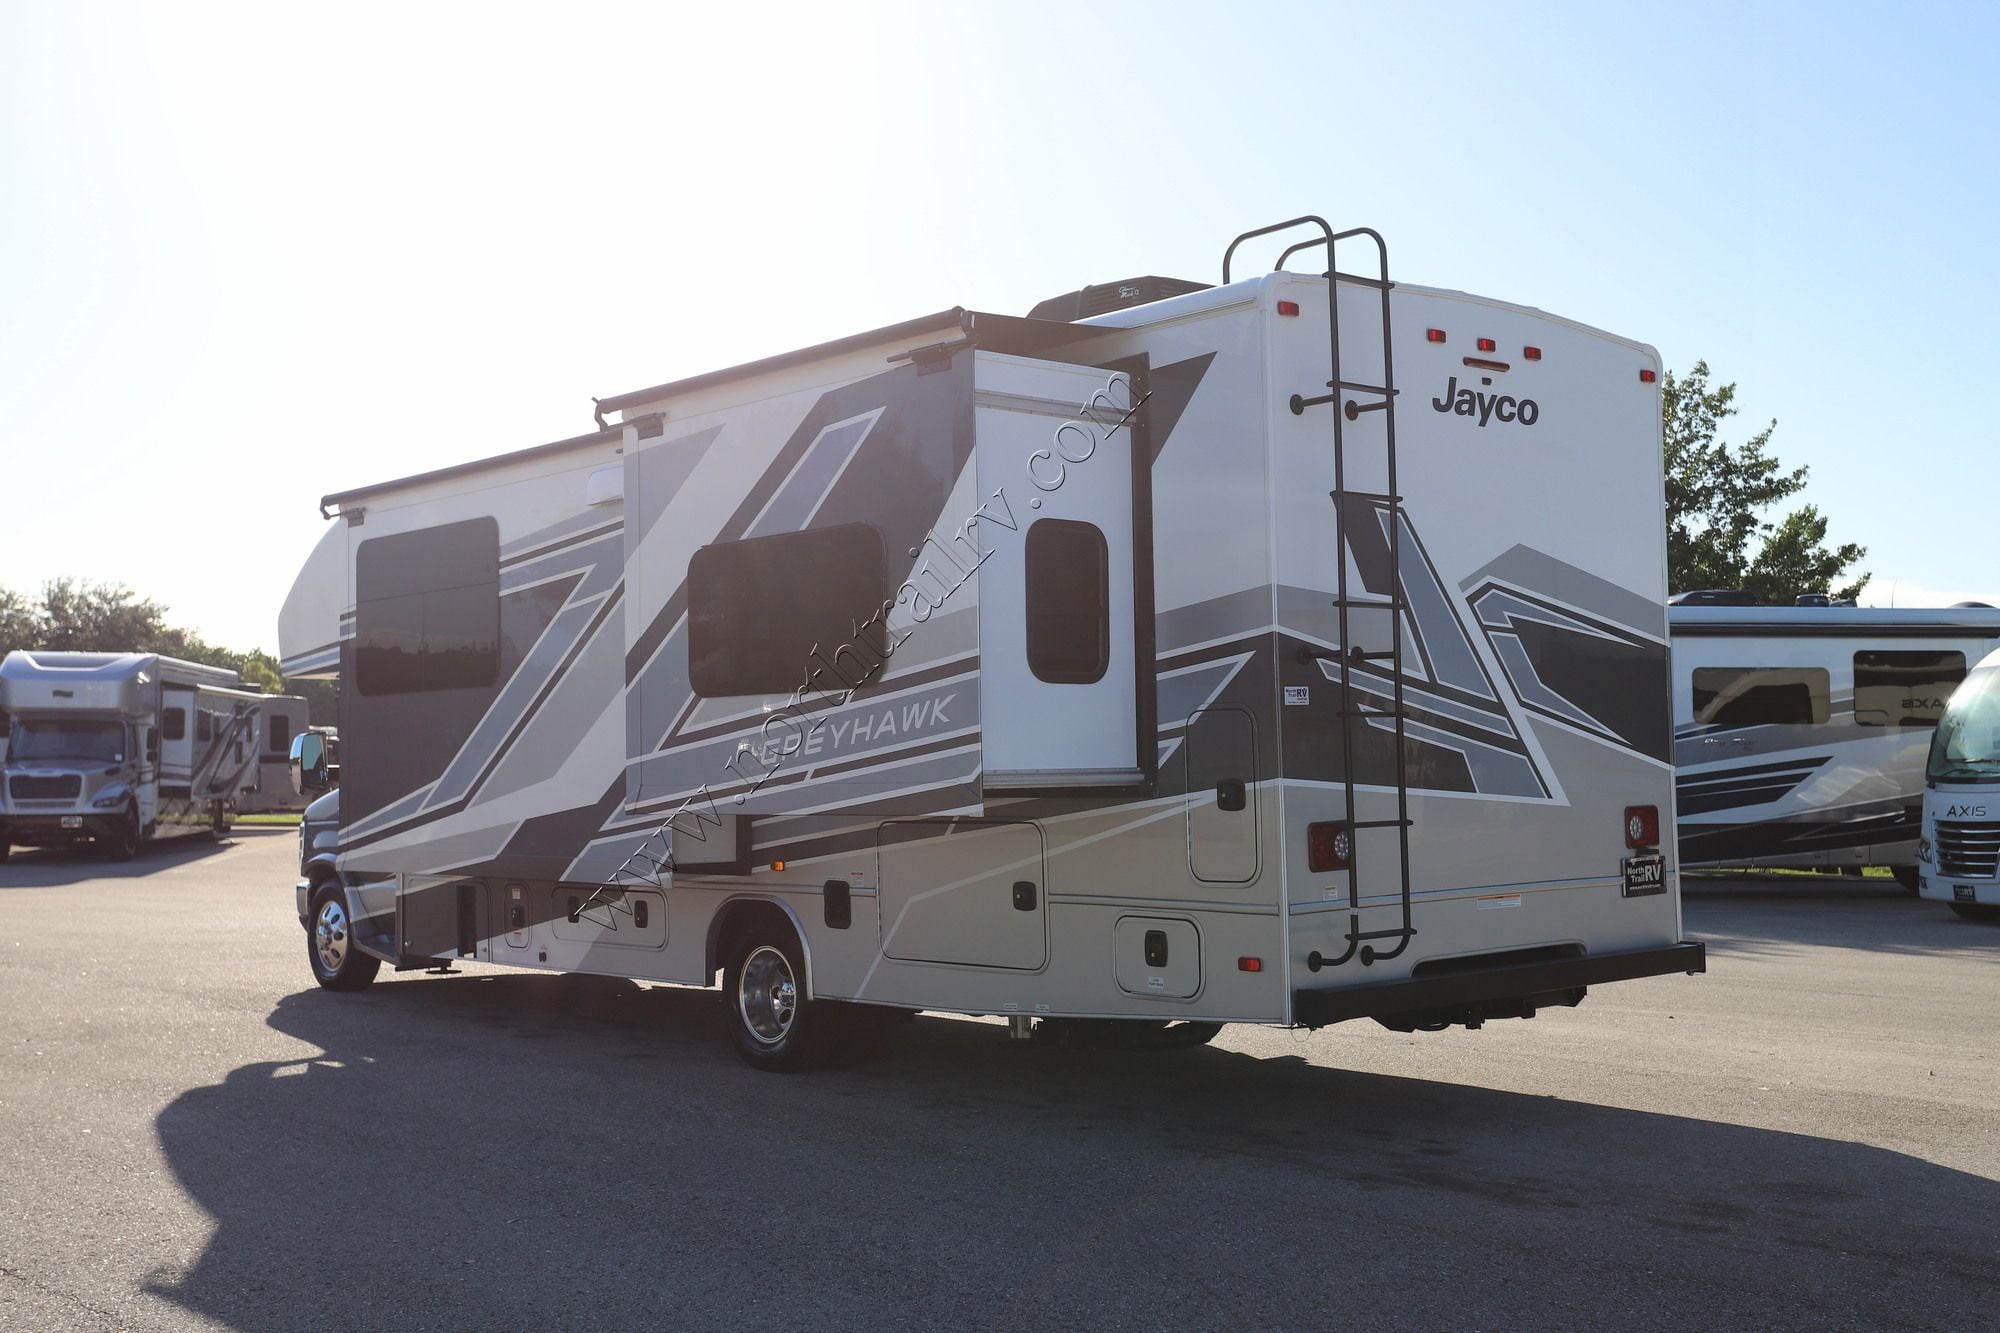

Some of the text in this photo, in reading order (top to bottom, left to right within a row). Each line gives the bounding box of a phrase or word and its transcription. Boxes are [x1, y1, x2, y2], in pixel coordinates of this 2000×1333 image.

[1432, 376, 1539, 427] Jayco
[1297, 688, 1308, 697] RV
[761, 693, 957, 766] GREYHAWK
[1946, 805, 1987, 817] AXIS
[1627, 866, 1645, 875] North
[1645, 864, 1661, 881] RV
[1631, 875, 1645, 883] Trail
